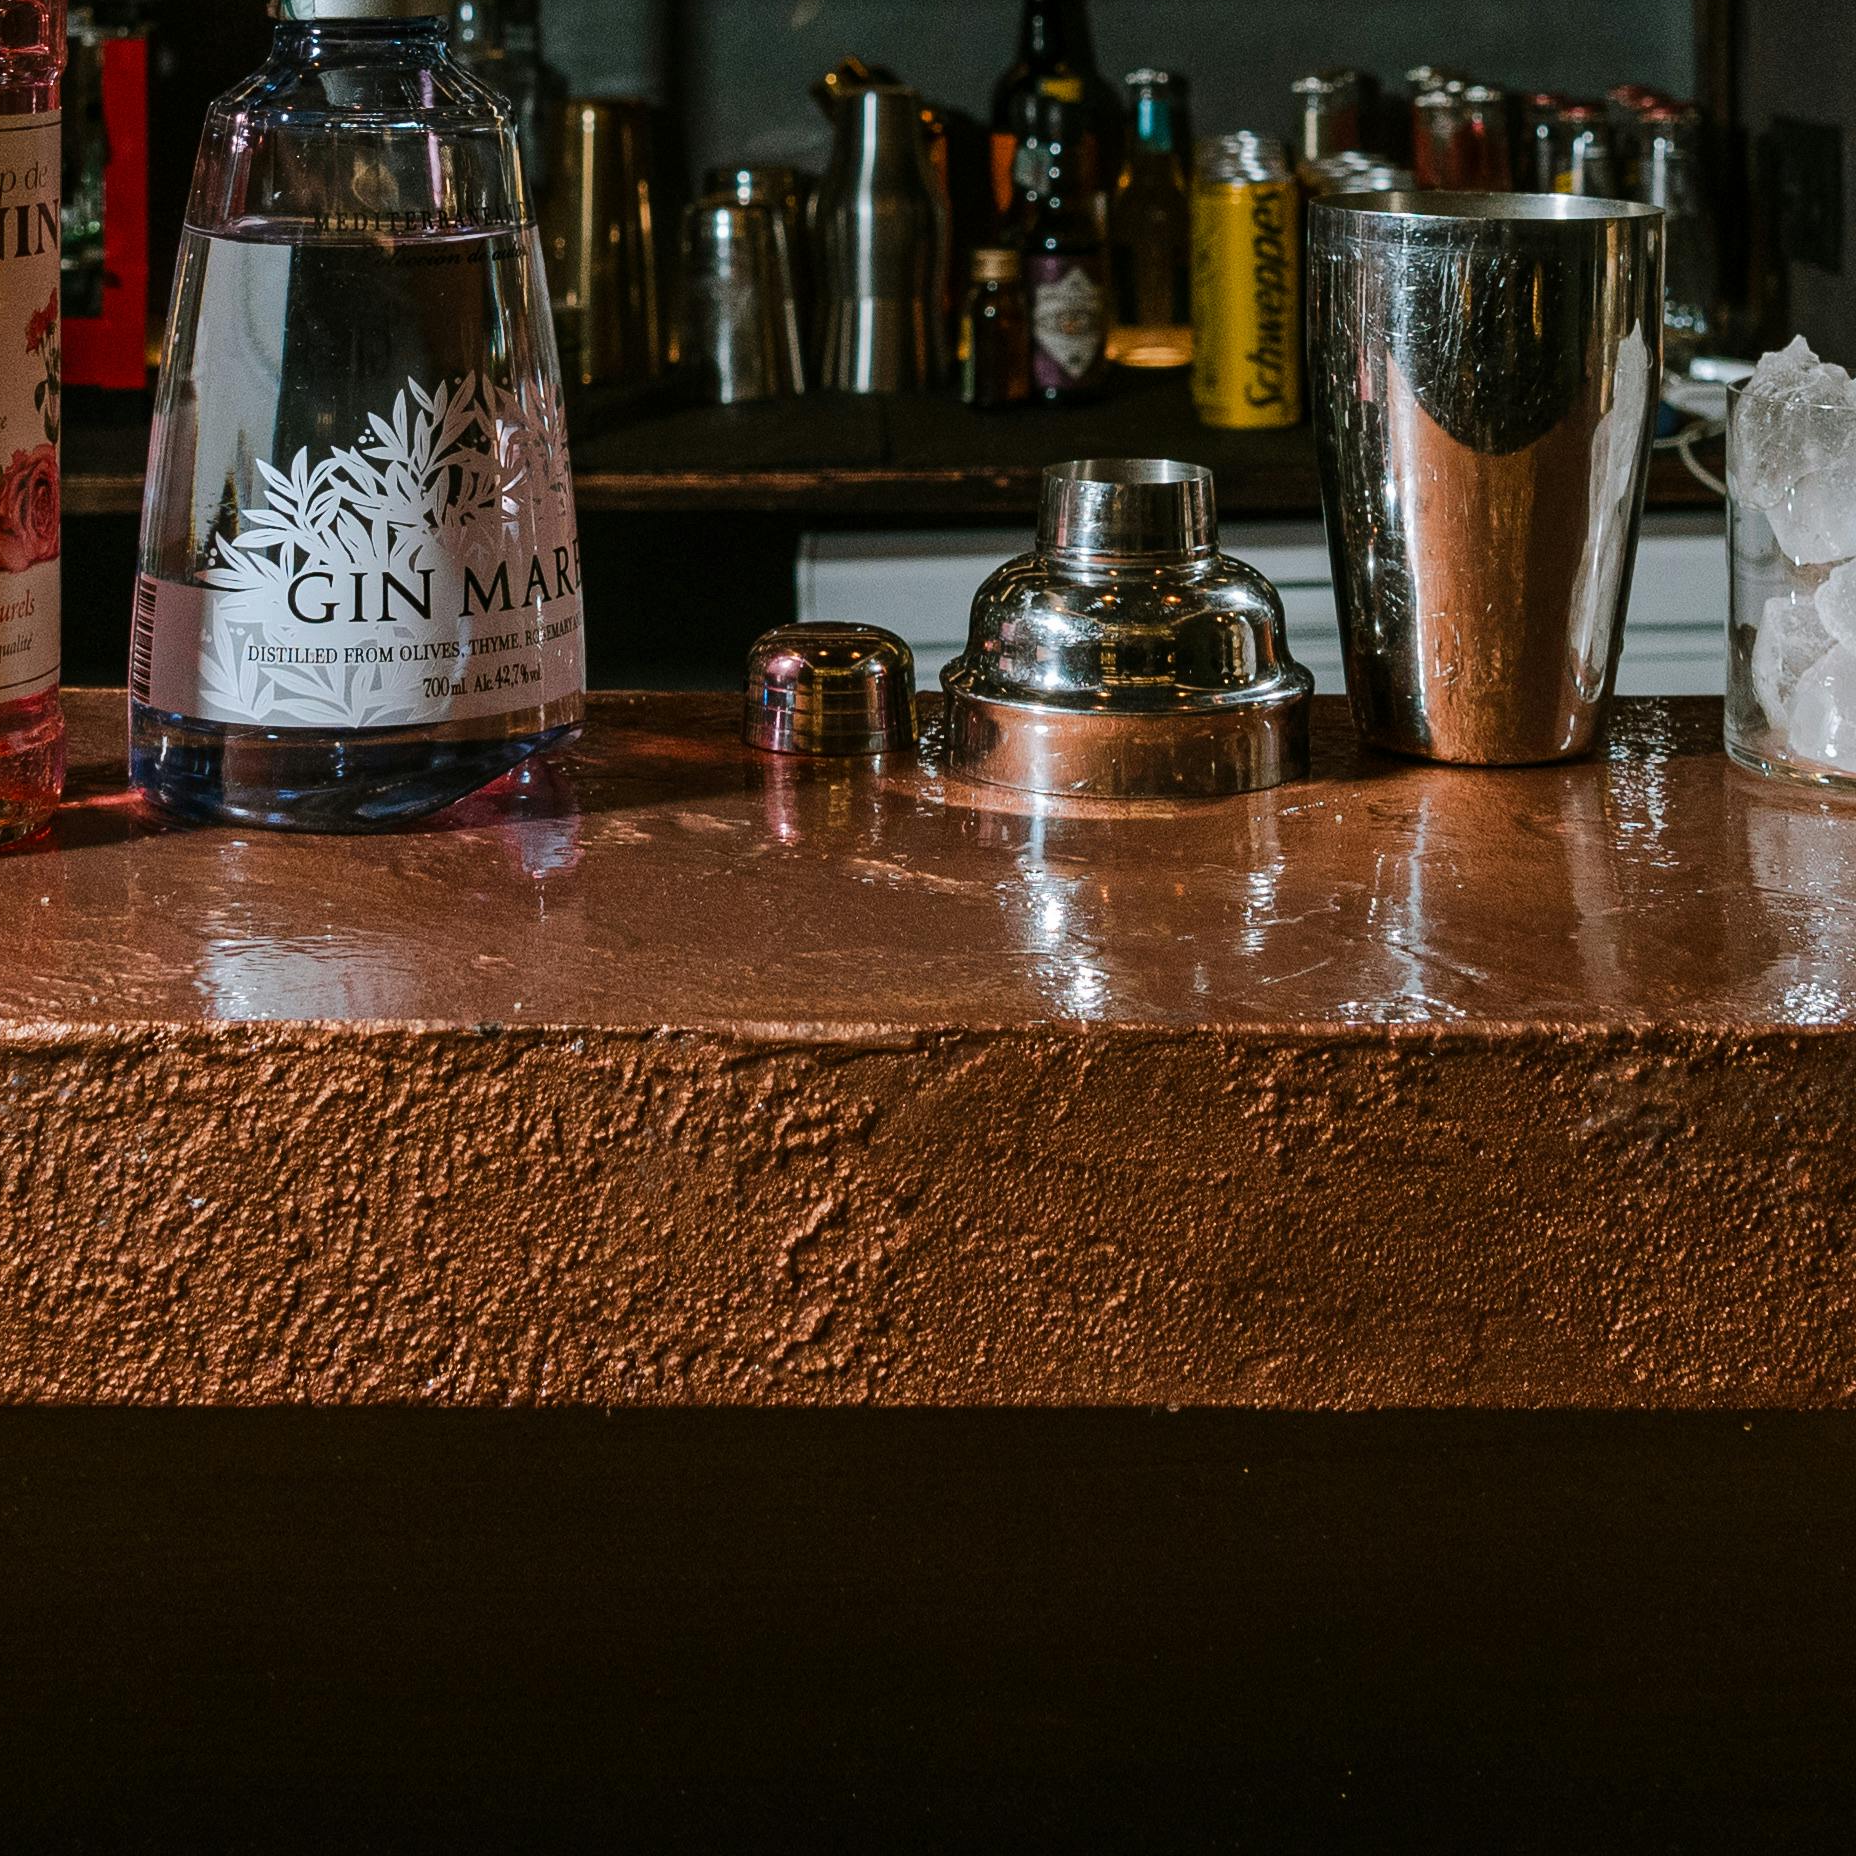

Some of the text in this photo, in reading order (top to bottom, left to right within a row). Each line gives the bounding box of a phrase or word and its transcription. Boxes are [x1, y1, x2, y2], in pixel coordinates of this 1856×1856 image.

[24, 161, 48, 191] de
[287, 569, 435, 624] GIN
[247, 645, 338, 664] DISTILLED
[344, 647, 395, 664] FROM
